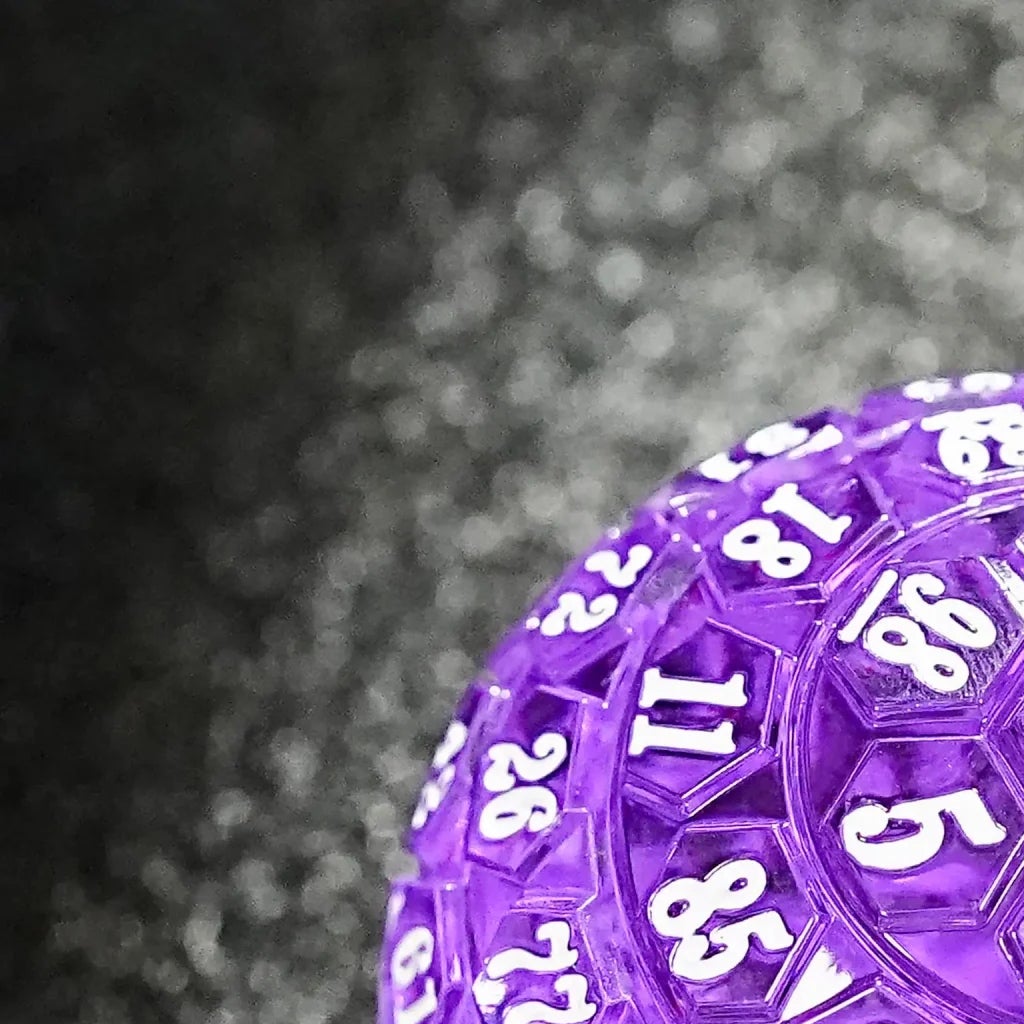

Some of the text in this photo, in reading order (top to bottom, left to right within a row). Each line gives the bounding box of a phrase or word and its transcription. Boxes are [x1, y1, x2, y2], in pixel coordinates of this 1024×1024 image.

[722, 483, 851, 579] 18
[862, 573, 998, 692] 98
[629, 667, 747, 756] 11
[478, 732, 568, 841] 26
[840, 789, 1007, 871] 5
[648, 859, 794, 982] 85
